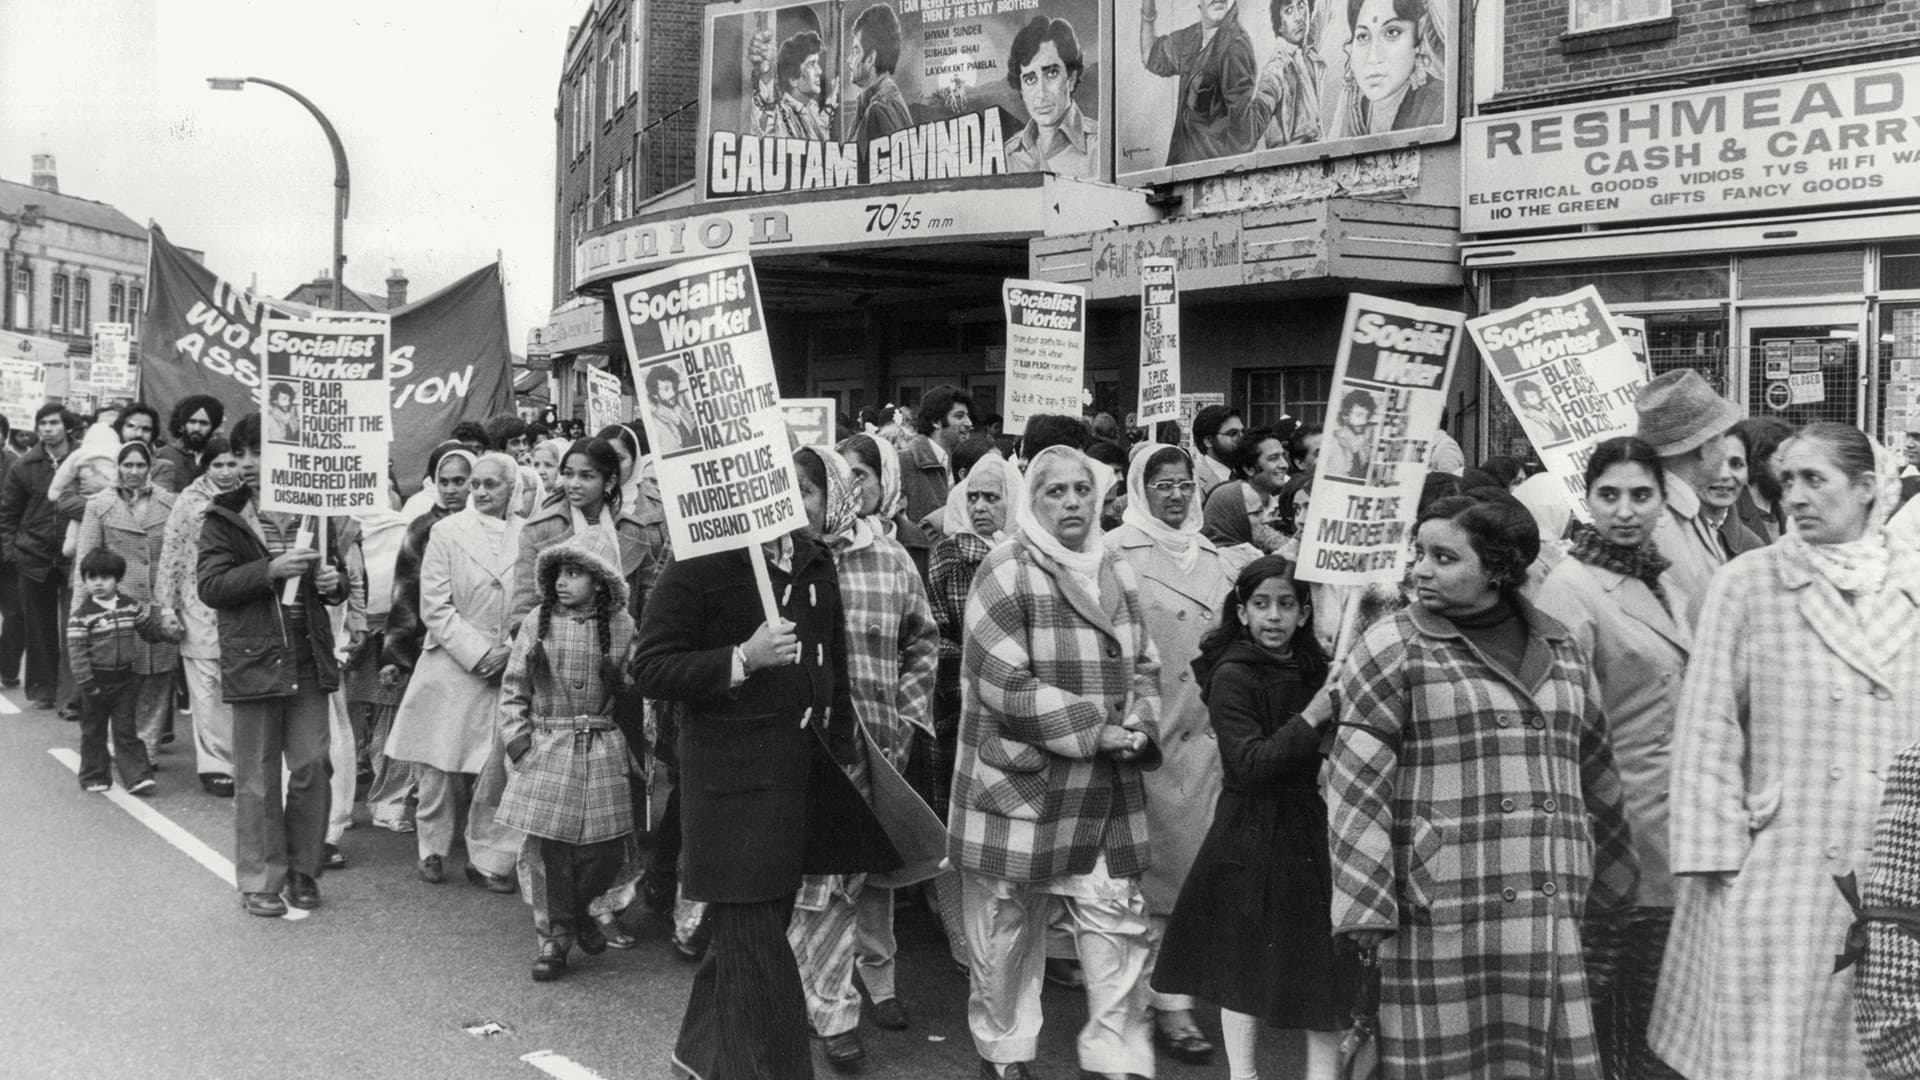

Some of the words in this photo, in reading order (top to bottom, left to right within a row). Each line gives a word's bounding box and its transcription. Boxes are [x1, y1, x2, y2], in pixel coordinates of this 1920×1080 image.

[922, 9, 943, 23] EVEN
[944, 8, 952, 20] IF
[954, 5, 966, 18] HE
[967, 4, 977, 16] IS
[979, 2, 994, 15] MY
[997, 0, 1039, 13] BROTHER
[924, 46, 957, 58] SUBHASH
[960, 44, 980, 54] GHAI
[1487, 72, 1904, 158] RESHMEAD
[711, 130, 858, 192] GAUTAM
[869, 105, 1007, 184] GOVINDA
[1584, 142, 1701, 176] CASH
[1719, 138, 1747, 163] &
[1469, 185, 1580, 205] ELECTRICAL
[1590, 176, 1659, 194] GOODS
[1680, 167, 1745, 185] VIDIOS
[1763, 161, 1809, 177] TVS
[1518, 204, 1551, 217] THE
[1558, 197, 1619, 213] GREEN
[1650, 190, 1706, 206] GIFTS
[1723, 183, 1792, 201] FANCY
[1802, 174, 1884, 193] GOODS
[928, 216, 953, 229] mm
[1212, 229, 1239, 267] Sound
[629, 268, 746, 325] Socialist
[1009, 289, 1077, 313] Socialist
[659, 306, 751, 351] Worker
[1022, 308, 1077, 330] Worker
[1483, 302, 1590, 351] Socialist
[268, 331, 376, 358] Socialist
[682, 342, 734, 376] BLAIR
[1513, 329, 1601, 370] Worker
[290, 355, 376, 380] Worker
[688, 365, 746, 401] PEACH
[1541, 357, 1587, 386] BLAIR
[1791, 374, 1821, 386] CLOSED
[302, 381, 342, 398] BLAIR
[696, 386, 757, 426] FOUGHT
[756, 382, 777, 410] THE
[1550, 376, 1600, 404] PEACH
[1561, 392, 1615, 423] FOUGHT
[1612, 380, 1643, 406] THE
[302, 398, 348, 415] PEACH
[302, 415, 355, 433] FOUGHT
[358, 416, 384, 432] THE
[302, 432, 356, 450] NAZIS...
[288, 453, 310, 471] THE
[313, 455, 362, 472] POLICE
[691, 462, 722, 488] THE
[723, 445, 775, 480] POLICE
[271, 469, 346, 490] MURDERED
[349, 472, 377, 489] HIM
[677, 475, 769, 519] MURDERED
[768, 467, 790, 495] HIM
[274, 489, 322, 507] DISBAND
[326, 493, 347, 507] THE
[350, 492, 374, 506] SPG
[688, 513, 751, 543] DISBAND
[752, 505, 776, 530] THE
[774, 496, 794, 522] SPG
